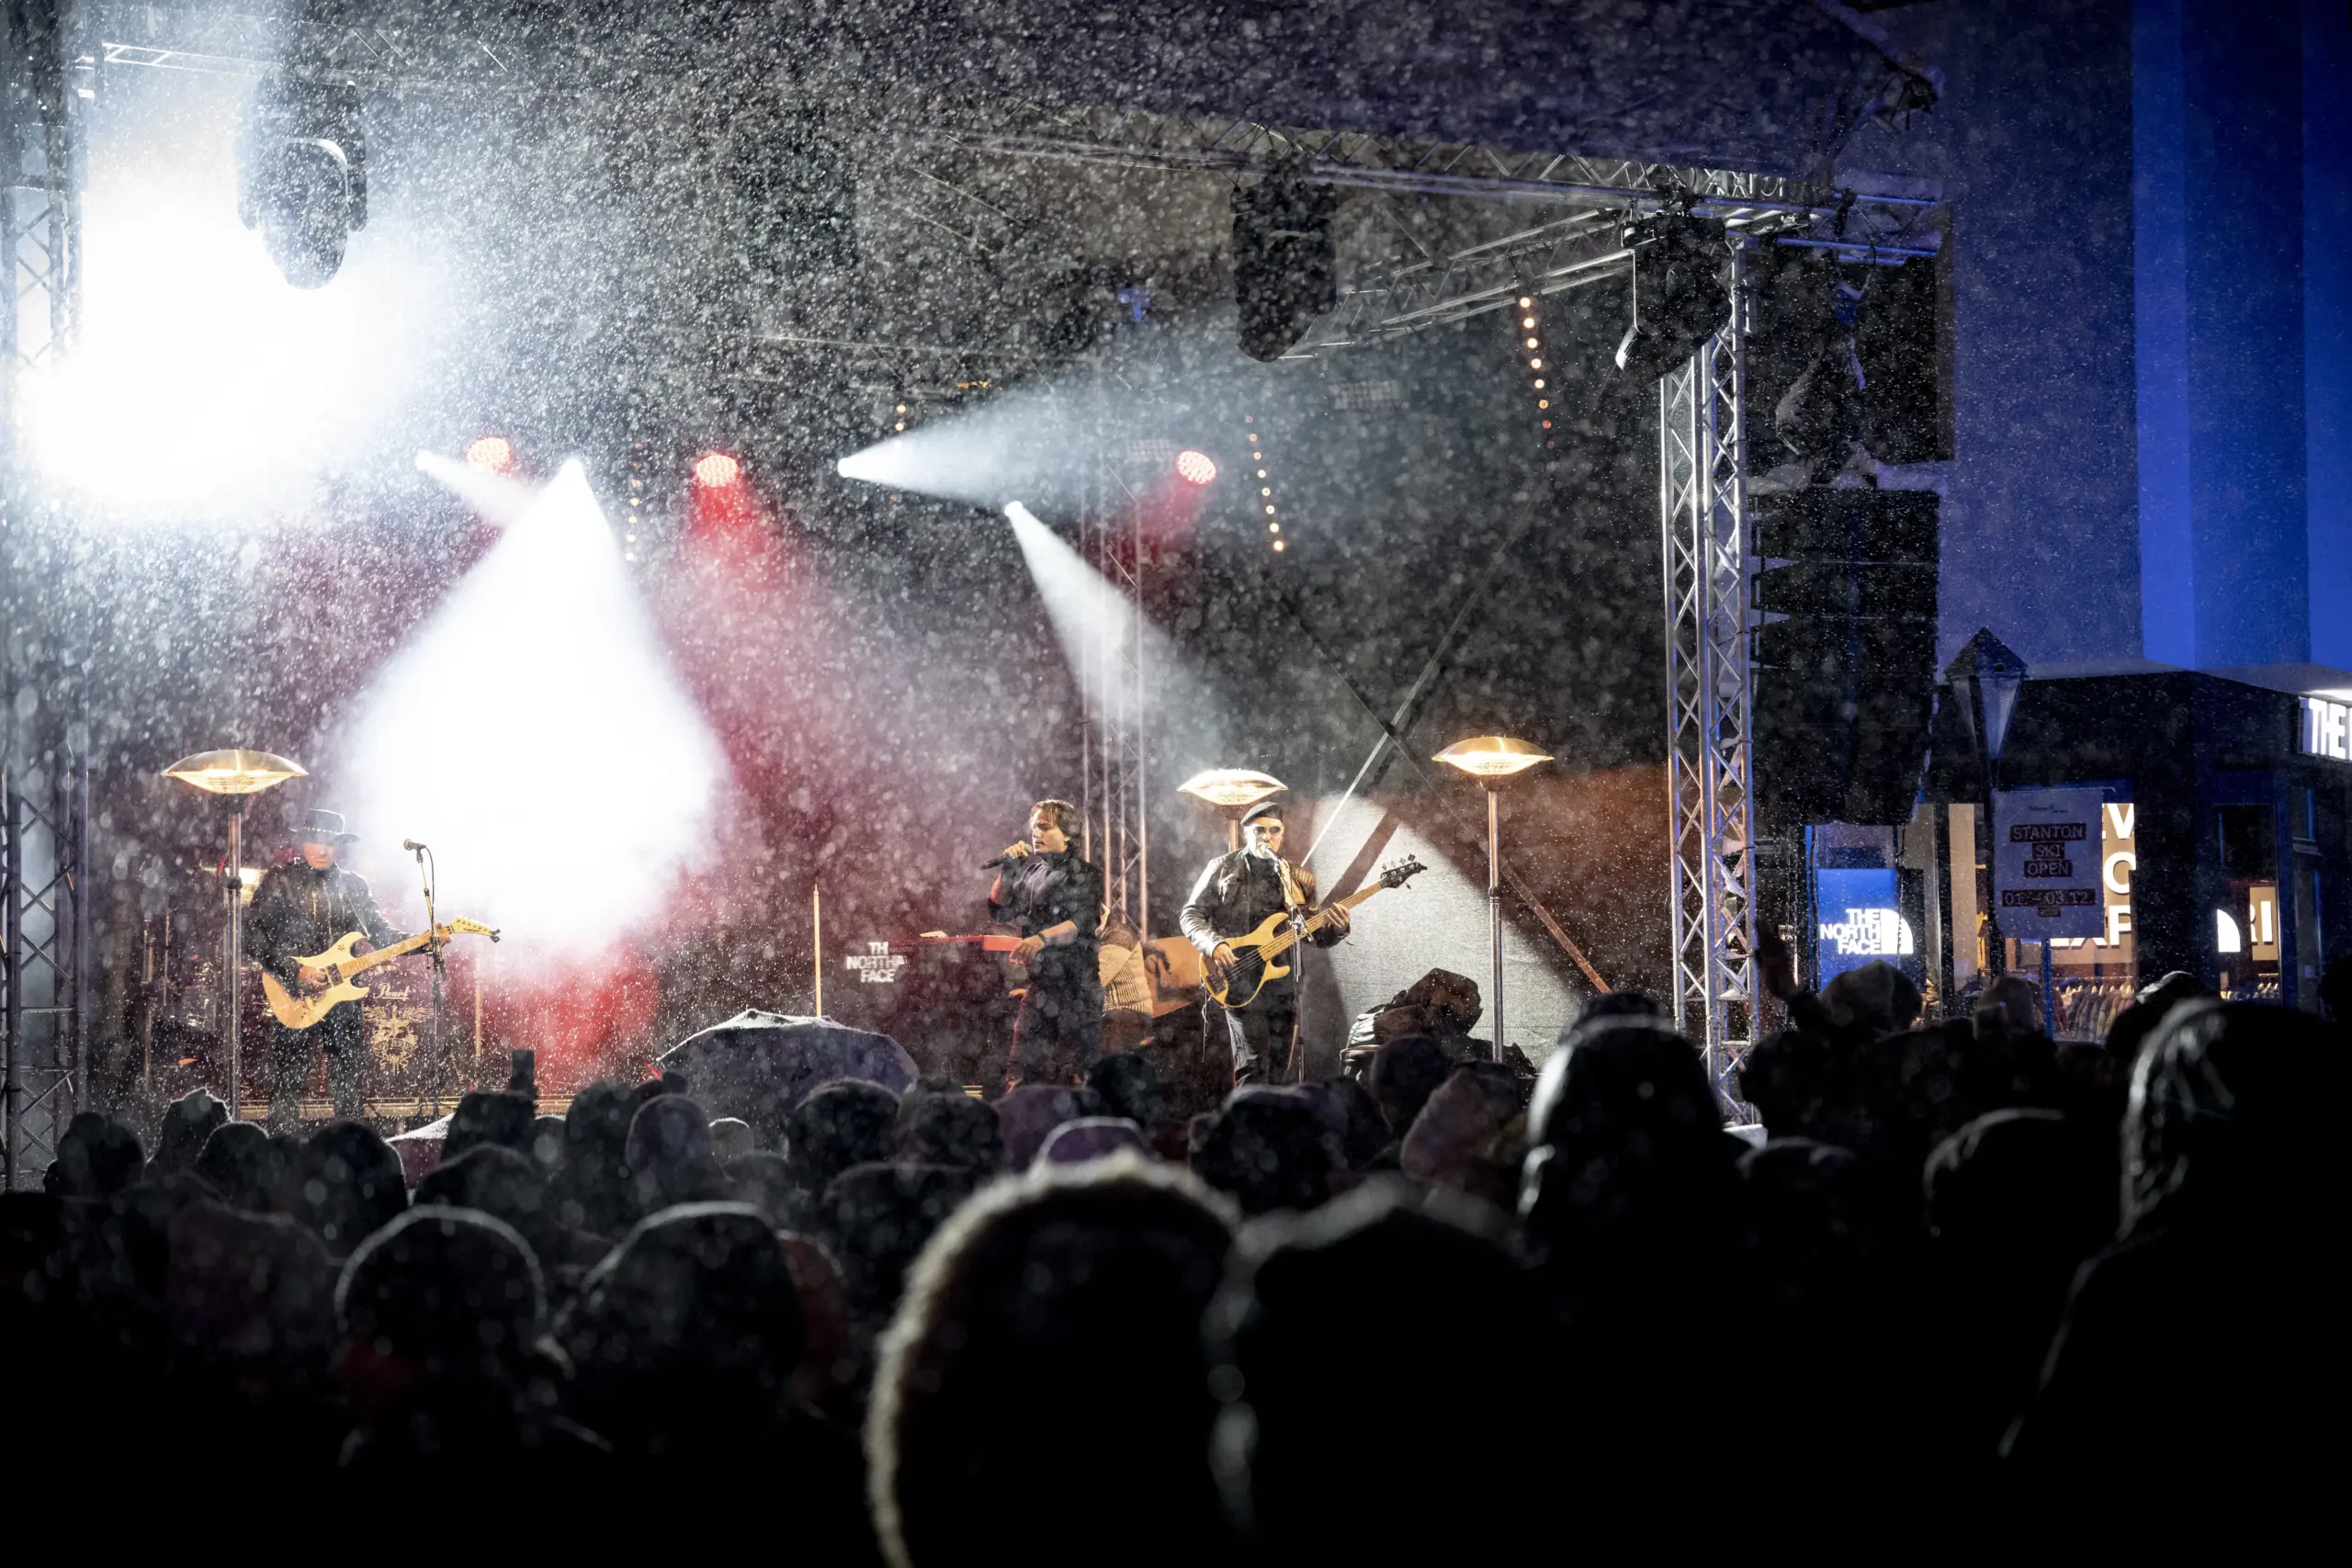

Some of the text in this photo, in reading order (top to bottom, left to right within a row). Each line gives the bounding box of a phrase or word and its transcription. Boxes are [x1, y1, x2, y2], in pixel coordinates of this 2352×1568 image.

[2309, 698, 2346, 759] THE
[2012, 826, 2083, 840] STANTON
[2035, 845, 2063, 857] SKI
[2027, 863, 2069, 876] OPEN
[1845, 908, 1881, 924] THE
[1820, 923, 1881, 939] NORTH
[1838, 939, 1881, 954] FACE
[846, 955, 894, 969] NORTH
[860, 969, 896, 983] FACE
